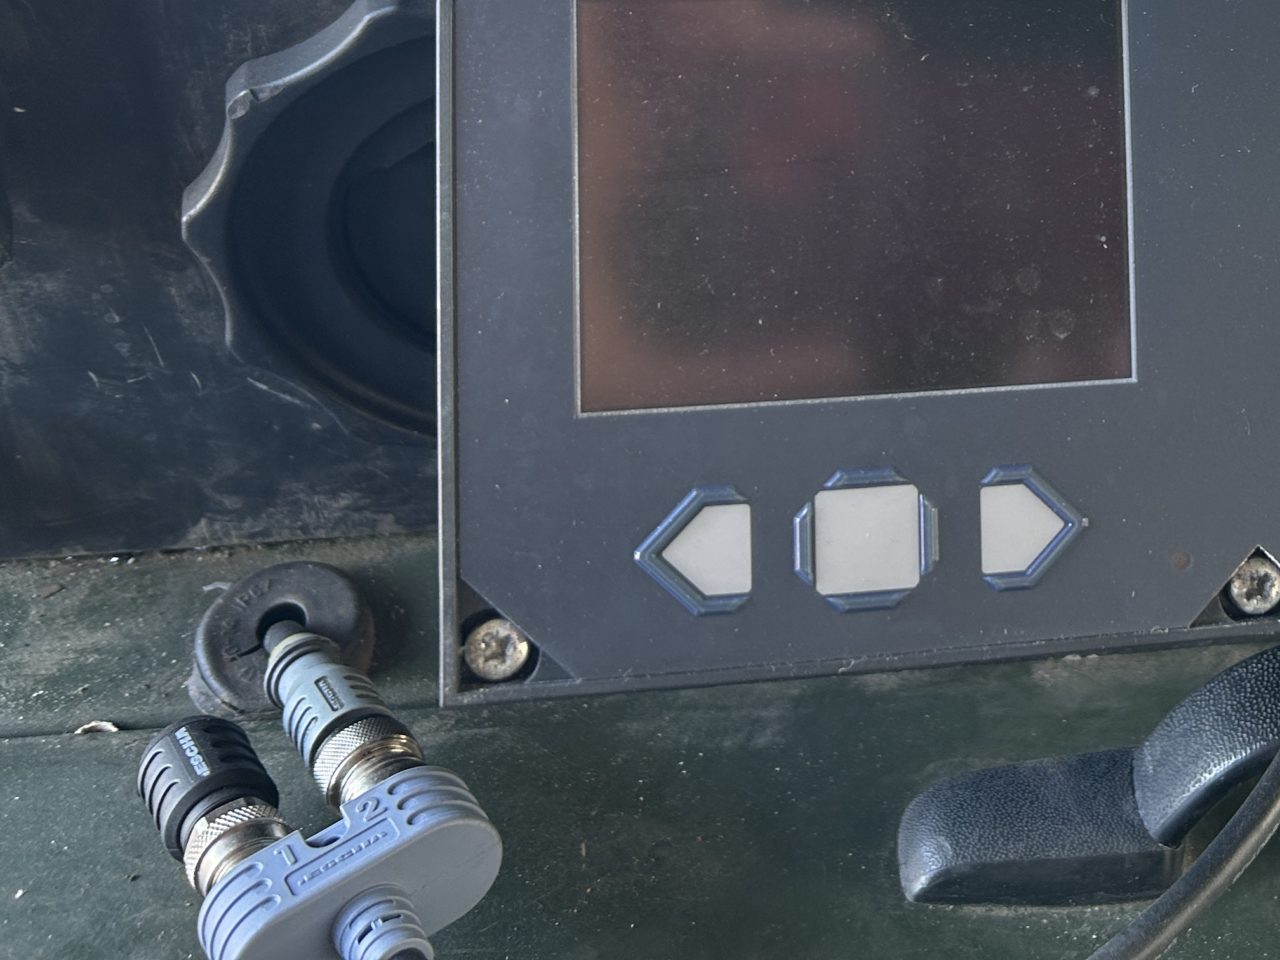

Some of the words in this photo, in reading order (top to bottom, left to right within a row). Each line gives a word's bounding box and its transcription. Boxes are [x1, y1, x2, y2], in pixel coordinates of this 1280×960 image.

[175, 726, 210, 776] ESCHA
[355, 797, 389, 822] 2
[273, 844, 298, 866] 1
